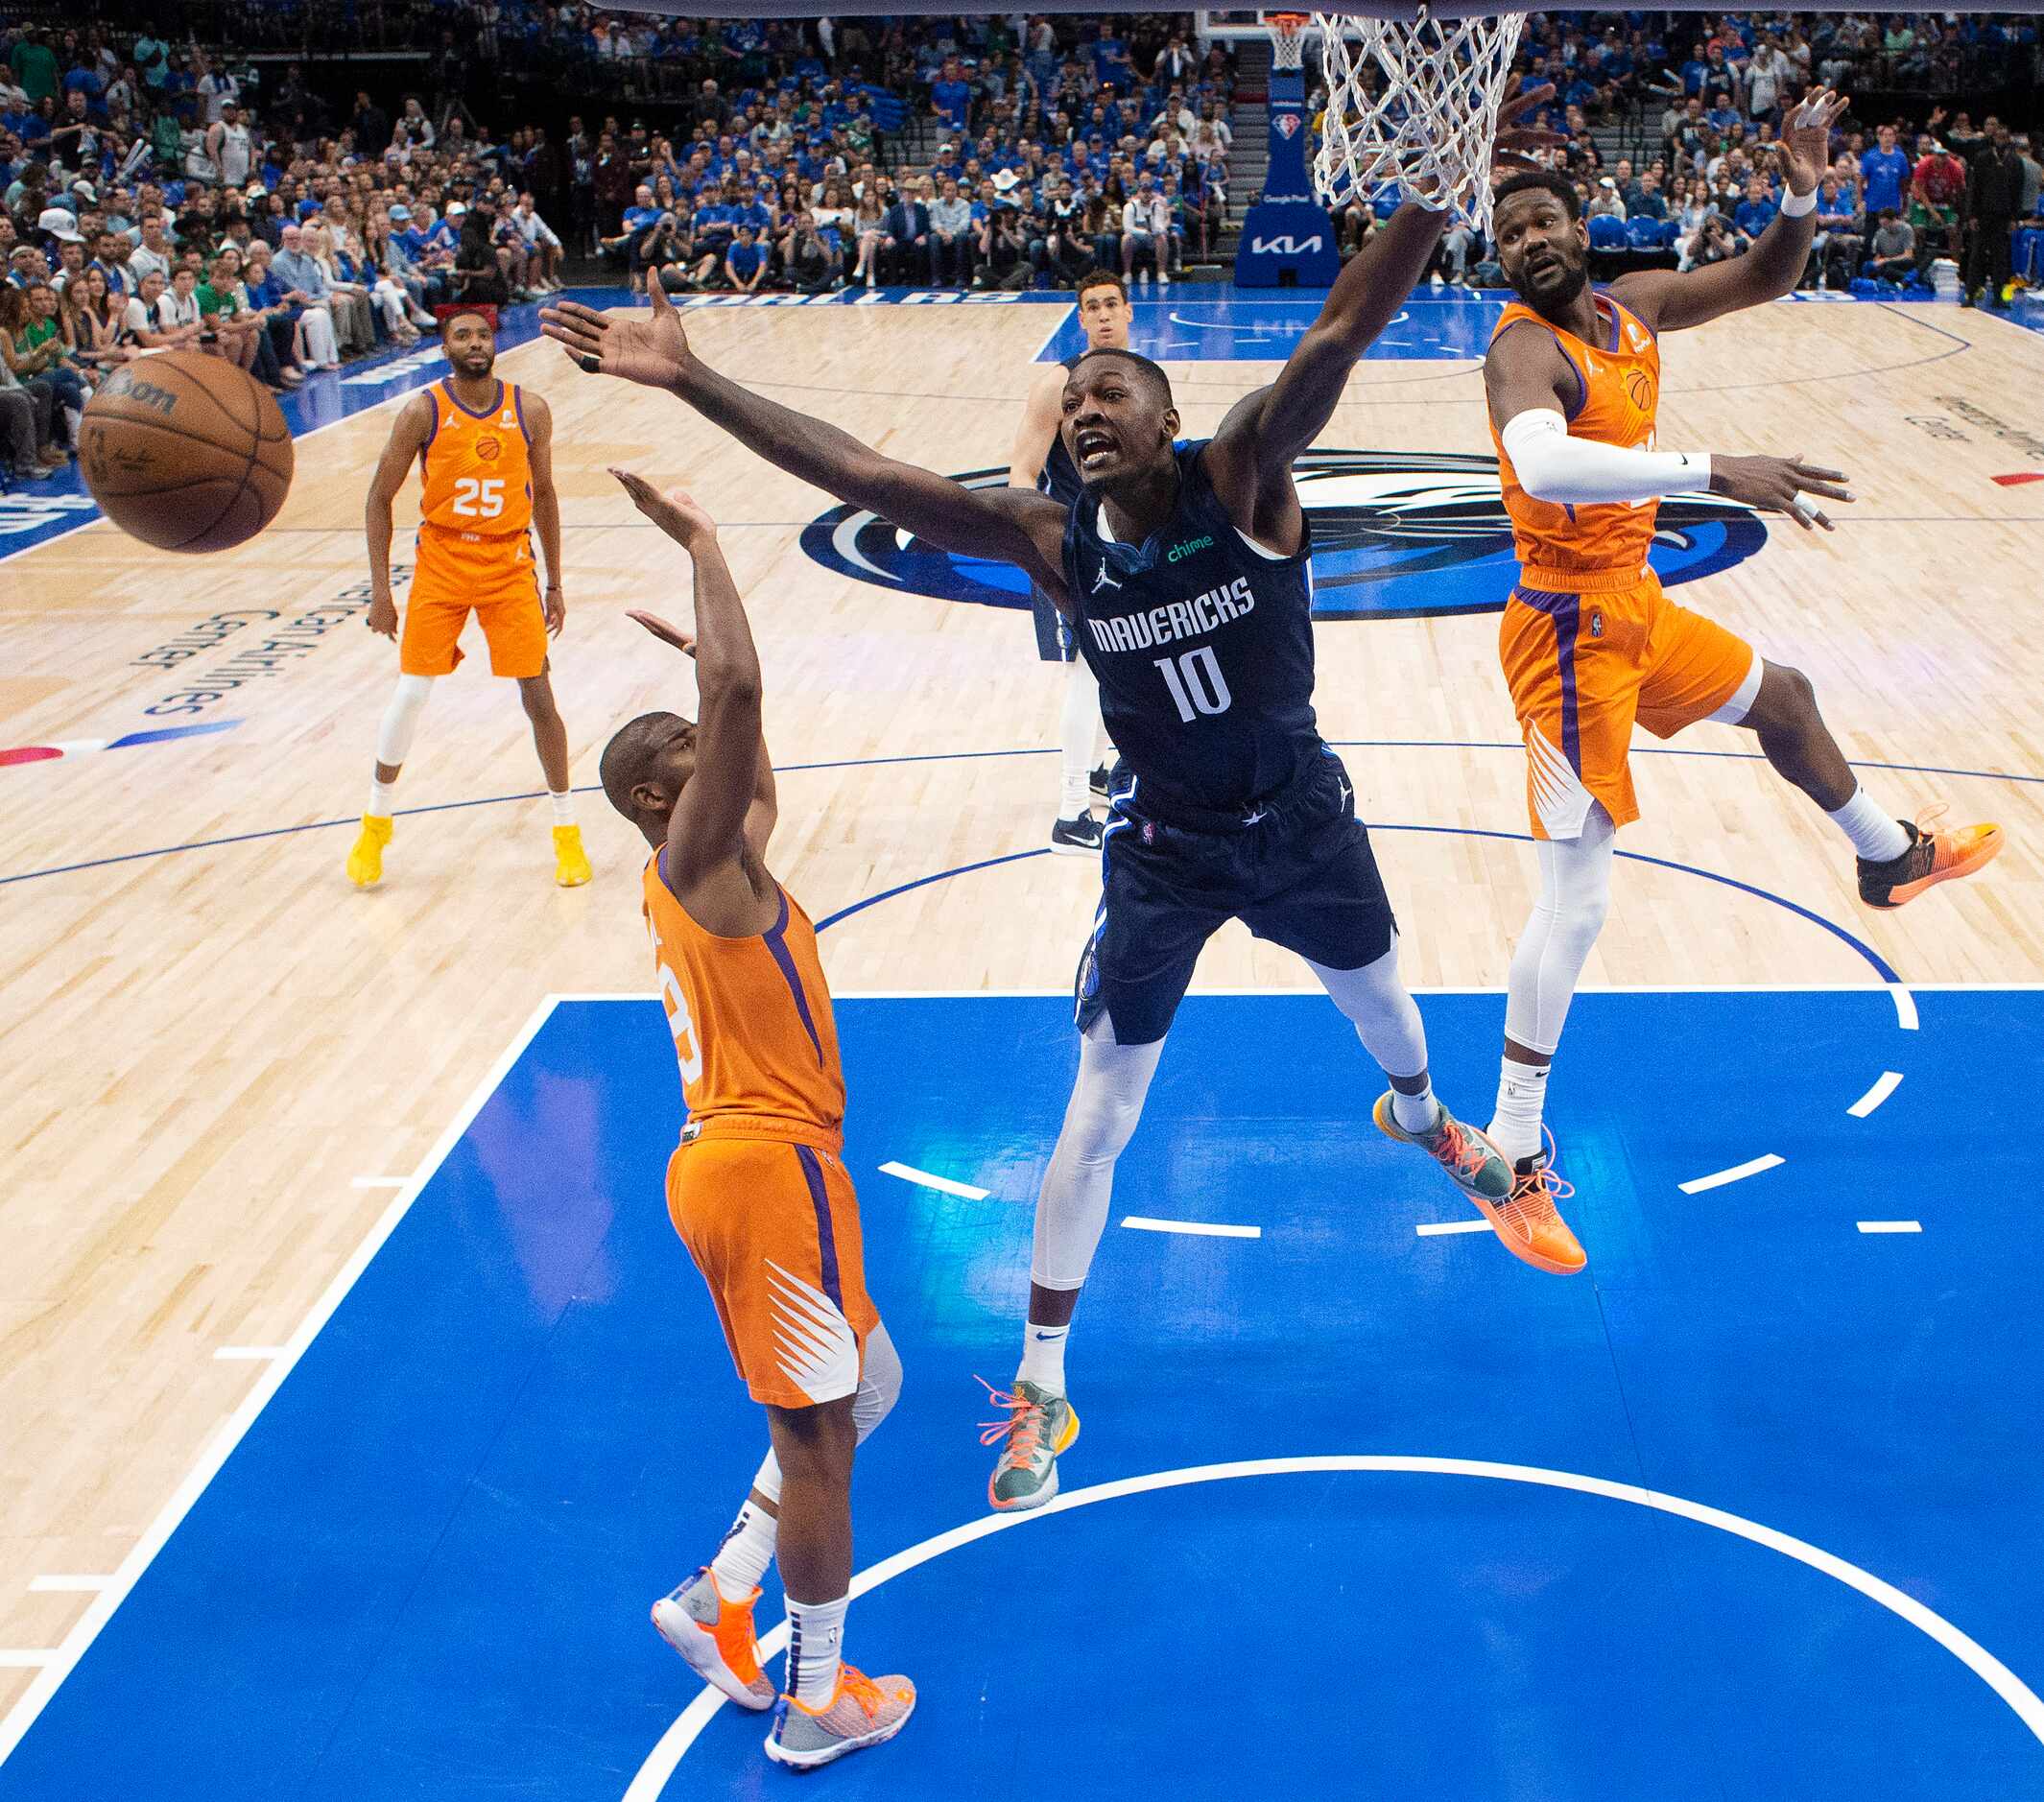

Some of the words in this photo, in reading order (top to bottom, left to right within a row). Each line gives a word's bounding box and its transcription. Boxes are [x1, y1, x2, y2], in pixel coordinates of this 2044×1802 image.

[1251, 236, 1322, 253] KIA
[683, 291, 1023, 306] DALLAS
[453, 478, 506, 517] 25
[1167, 535, 1214, 562] chime
[1088, 576, 1255, 652] MAVERICKS
[129, 609, 280, 669] Center
[143, 640, 318, 715] Airlines
[1153, 646, 1232, 723] 10
